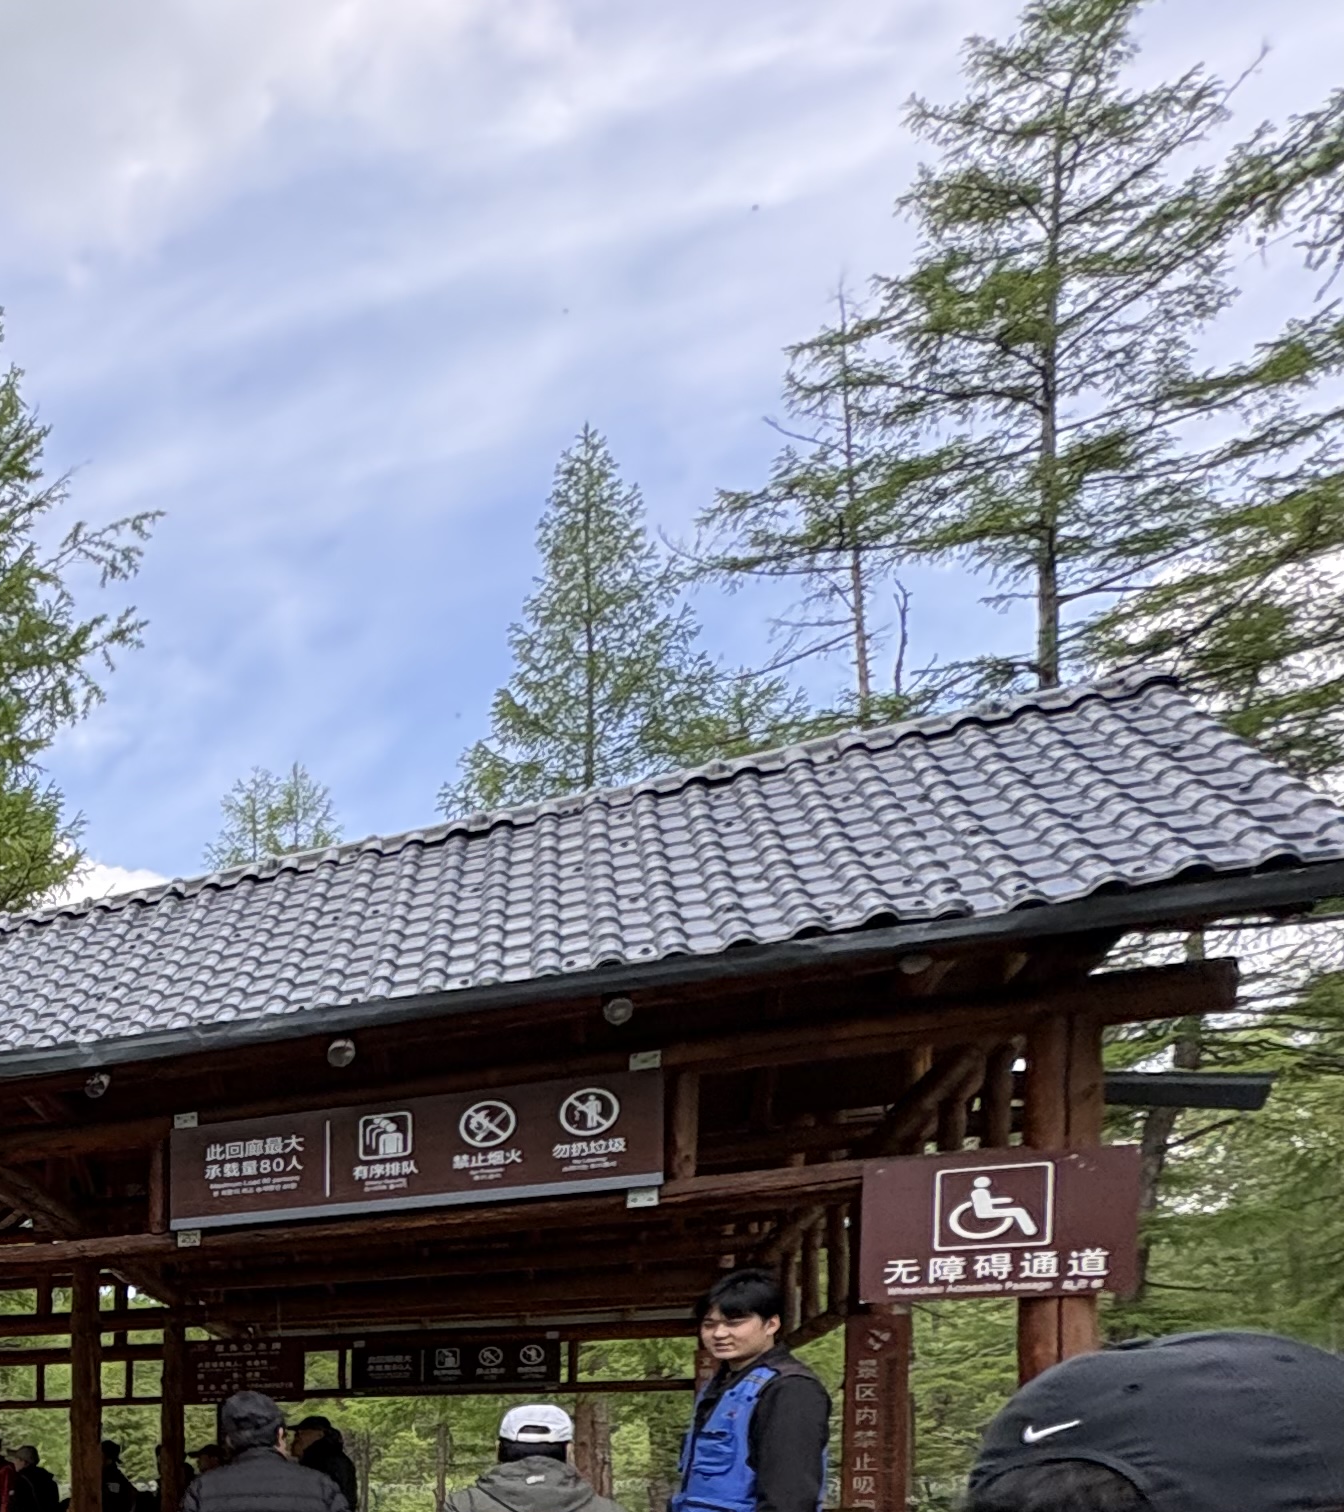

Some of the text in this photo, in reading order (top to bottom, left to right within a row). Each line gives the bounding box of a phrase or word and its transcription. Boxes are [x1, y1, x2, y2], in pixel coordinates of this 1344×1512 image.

[205, 1134, 305, 1161] 此回廊最大
[552, 1137, 627, 1159] 勿扔垃圾
[205, 1155, 304, 1180] 承载量80人
[352, 1159, 419, 1181] 有序排队
[452, 1149, 523, 1170] 禁止烟火
[883, 1247, 1111, 1285] 无障碍通道
